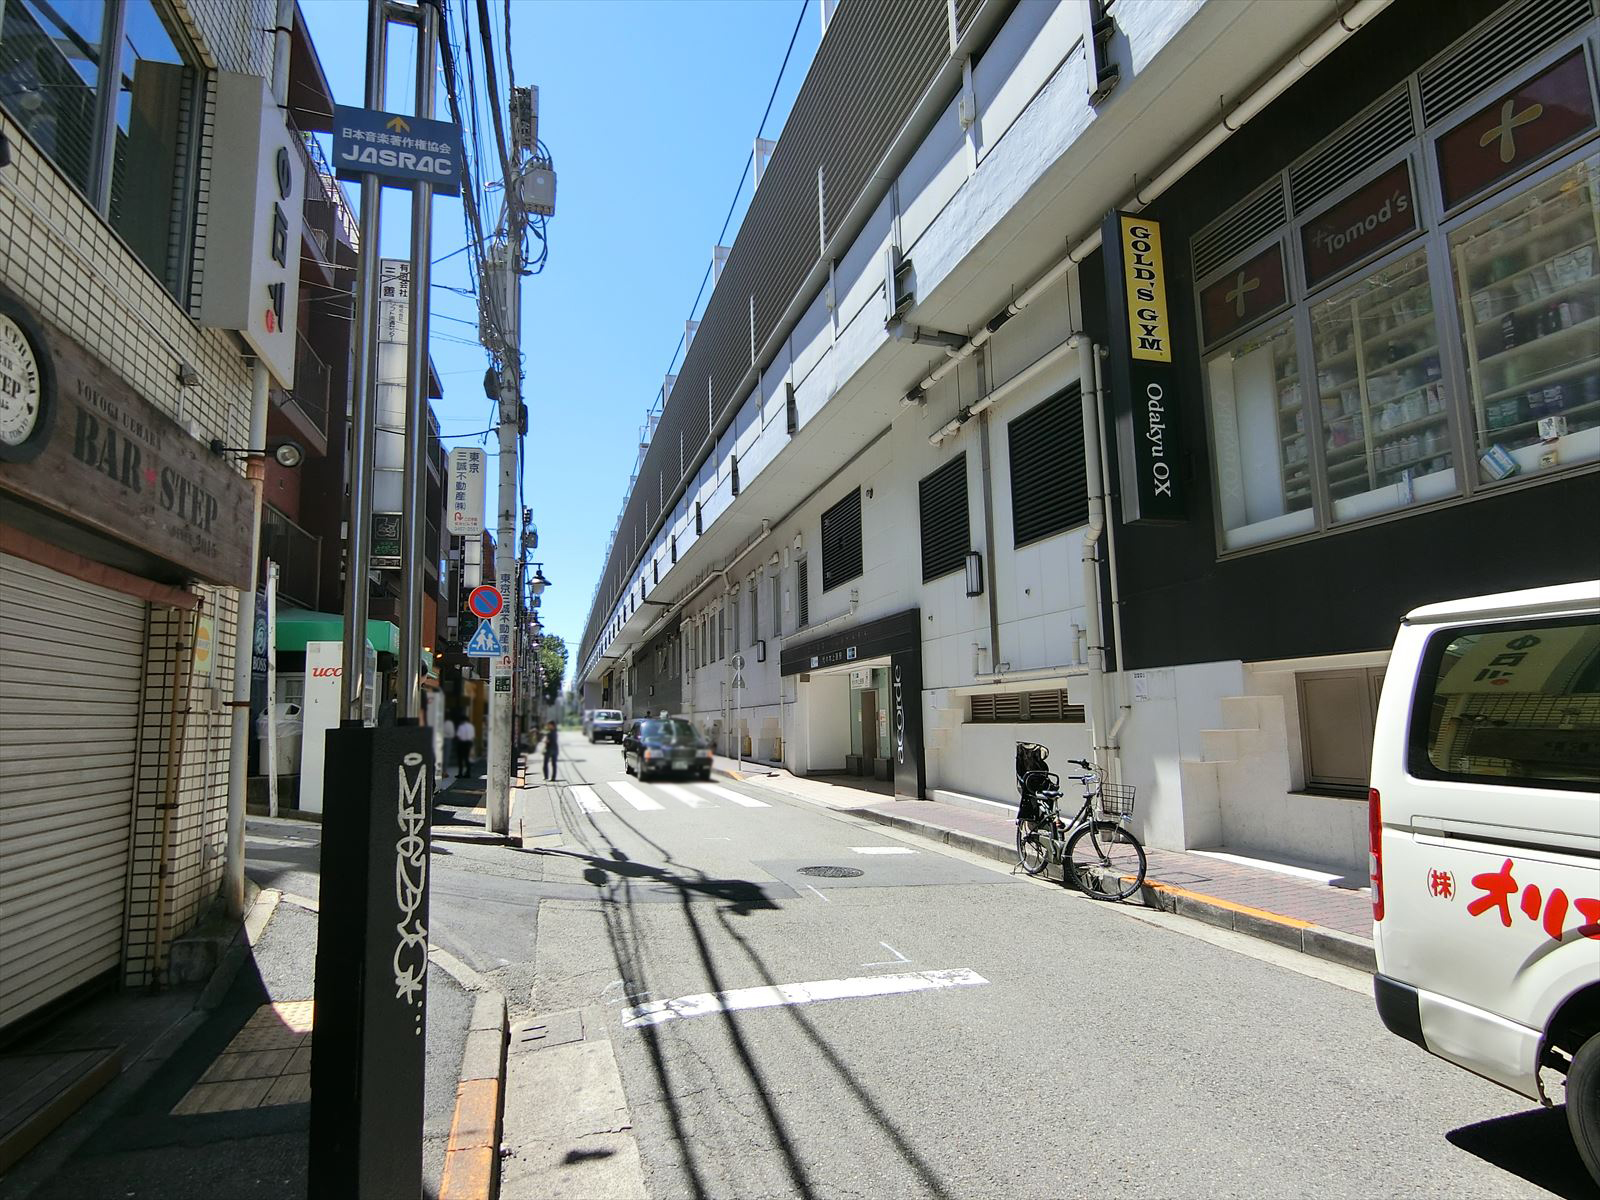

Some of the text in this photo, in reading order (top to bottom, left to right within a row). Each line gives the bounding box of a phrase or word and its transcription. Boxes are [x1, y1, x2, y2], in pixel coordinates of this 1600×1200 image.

[341, 144, 453, 176] JASRAC
[342, 127, 452, 155] 日本音楽著作権協会
[1323, 189, 1409, 255] Tomod's
[1130, 226, 1163, 352] GOLD'S GYM
[468, 452, 480, 474] 東京
[1146, 383, 1172, 498] Odakyu OX
[72, 405, 218, 533] BAR STEP
[252, 656, 267, 673] BOSS
[894, 664, 905, 765] acorde
[1427, 867, 1456, 902] (株)
